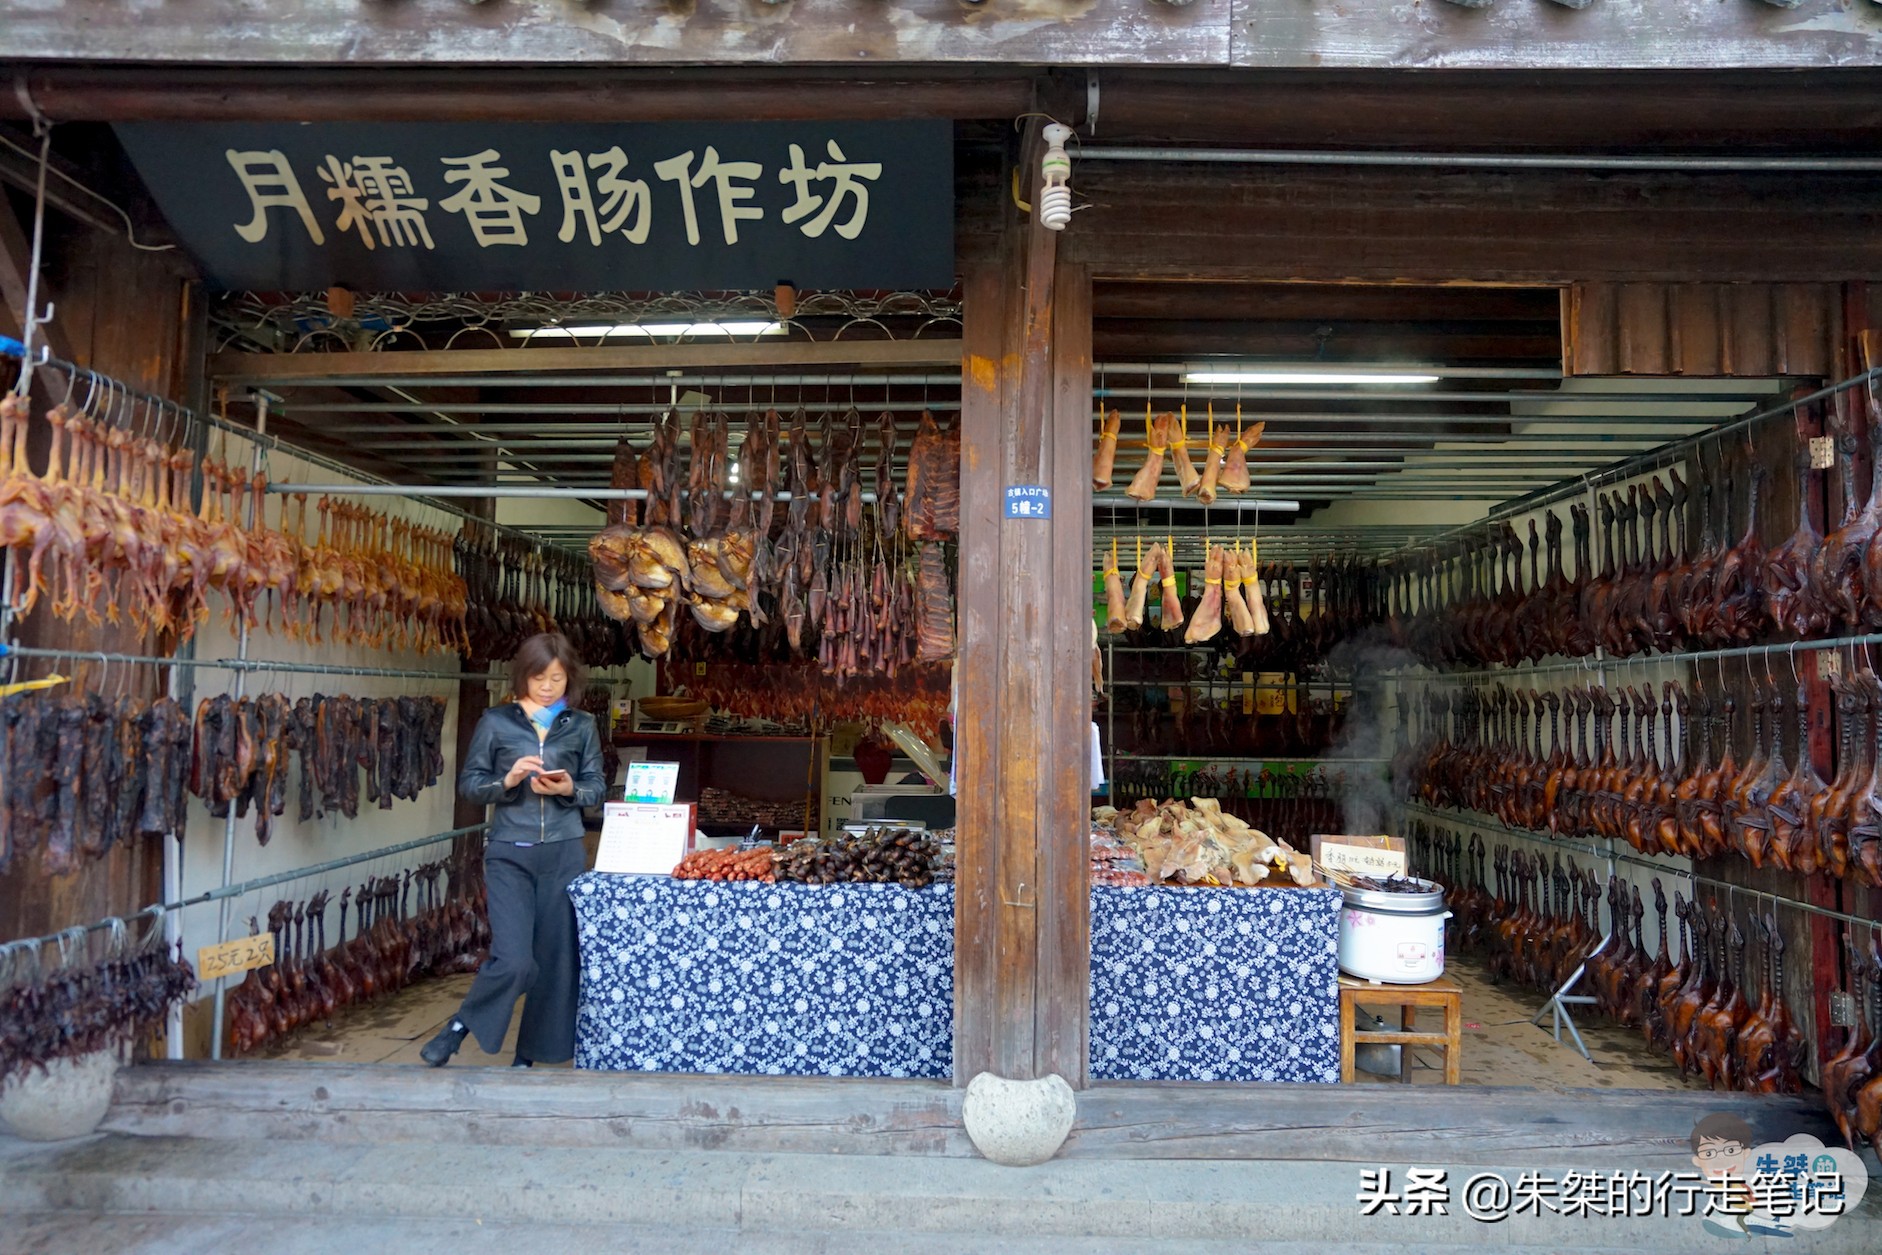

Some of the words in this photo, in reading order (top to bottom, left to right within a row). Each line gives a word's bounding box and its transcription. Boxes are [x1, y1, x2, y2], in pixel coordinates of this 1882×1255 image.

[226, 140, 883, 250] 月糯香肠作坊
